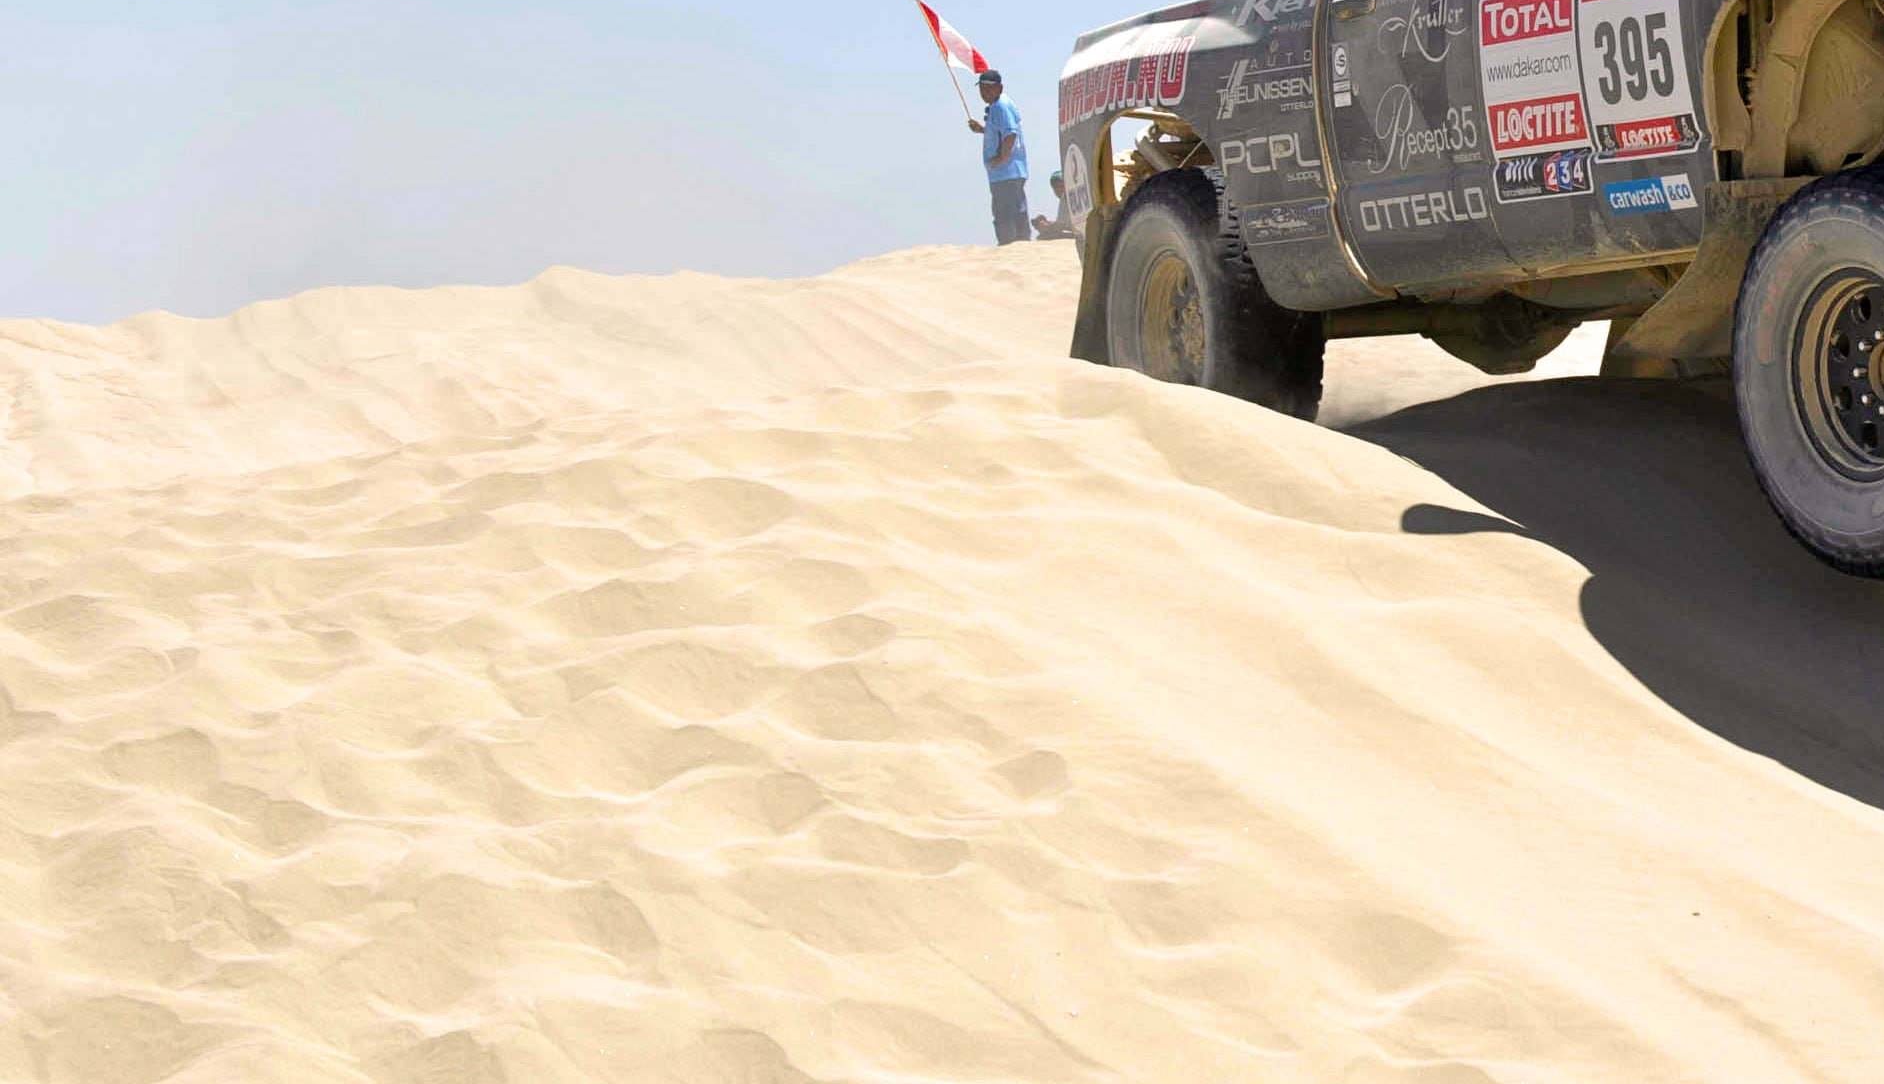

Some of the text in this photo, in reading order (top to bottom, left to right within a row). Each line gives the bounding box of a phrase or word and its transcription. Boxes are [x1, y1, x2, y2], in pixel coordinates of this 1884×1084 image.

[1484, 0, 1571, 39] TOTAL
[1250, 49, 1312, 69] AUTO
[1487, 53, 1573, 83] www.dakar.com
[1594, 12, 1675, 105] 395
[1496, 100, 1575, 144] LOCTITE
[1621, 124, 1673, 148] LOCTITE
[1220, 132, 1321, 177] PCPL
[1360, 186, 1488, 231] OTTERLO
[1609, 183, 1665, 210] carwash
